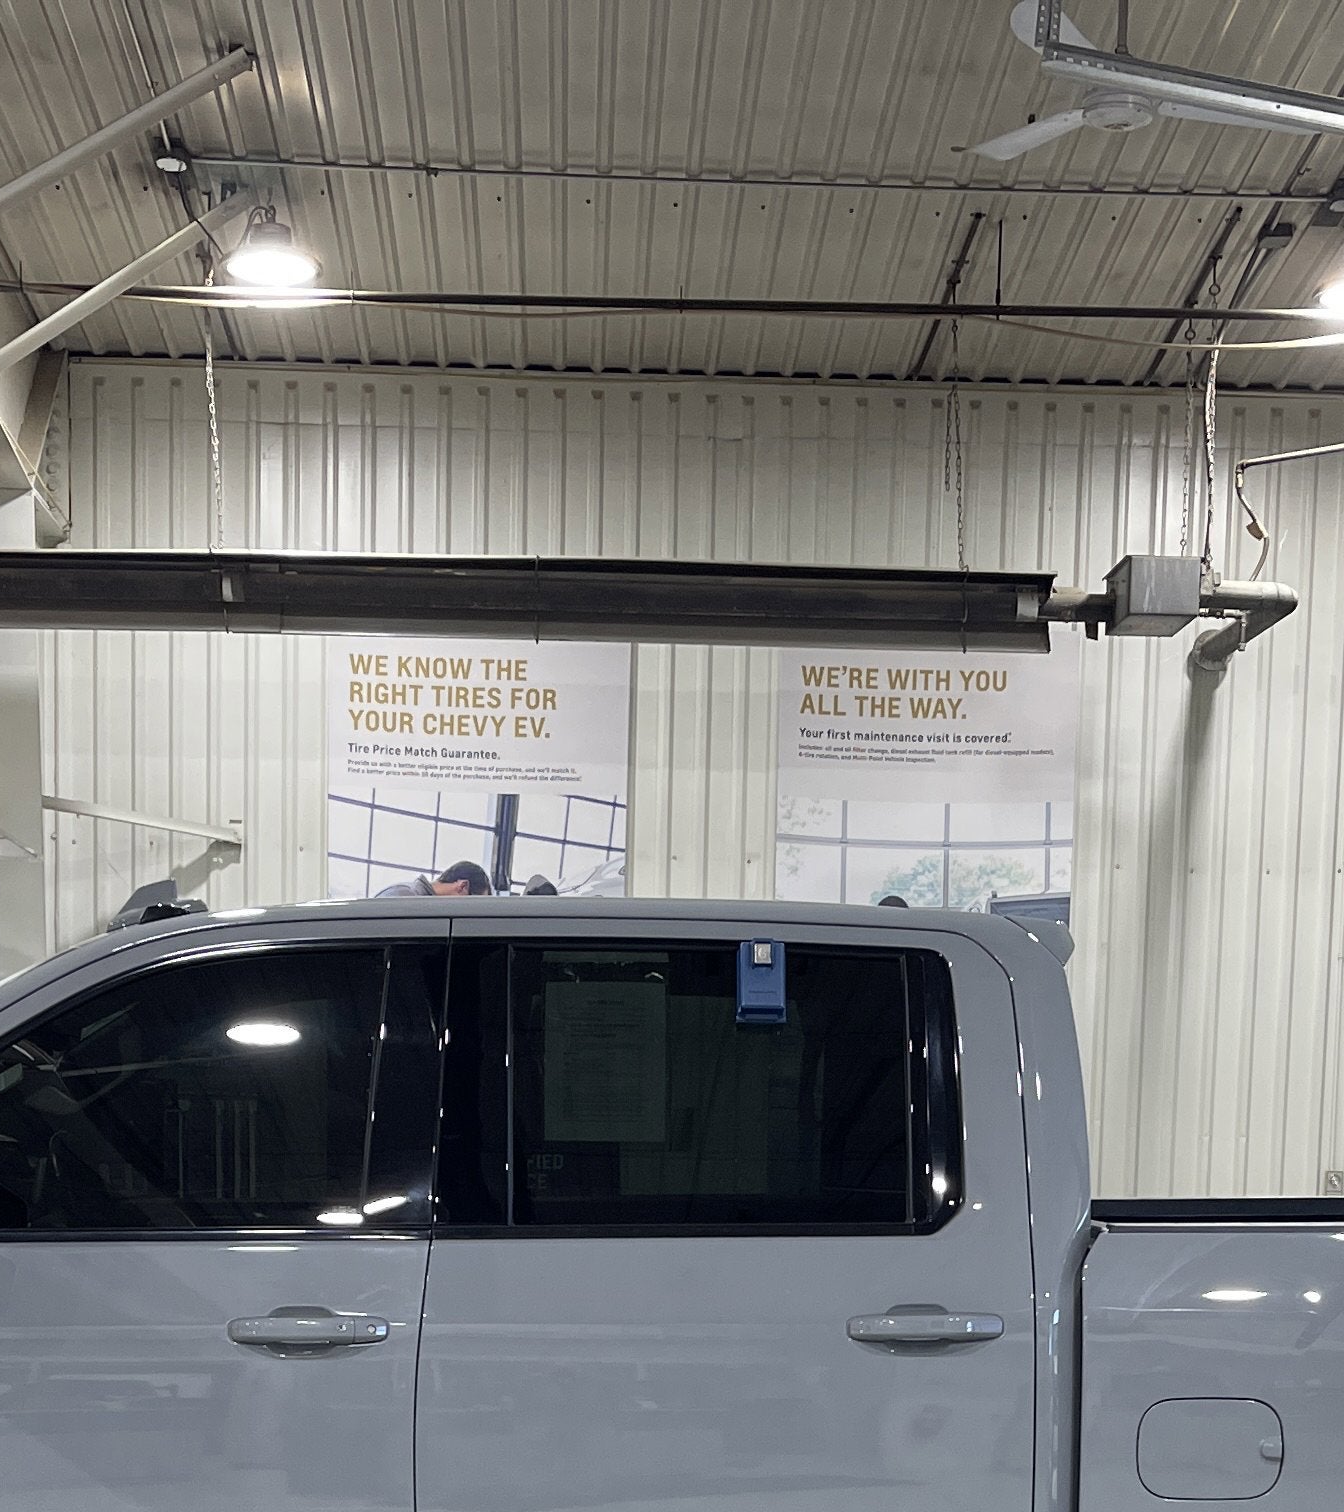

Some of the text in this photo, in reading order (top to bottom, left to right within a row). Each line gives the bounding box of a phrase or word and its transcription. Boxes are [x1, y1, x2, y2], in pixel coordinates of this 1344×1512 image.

[349, 653, 528, 681] WE KNOW THE
[801, 665, 1007, 692] WE'RE WITH YOU
[349, 681, 557, 710] RIGHT TIRES FOR
[800, 693, 967, 719] ALL THE WAY.
[348, 710, 550, 738] YOUR CHEVY EV.
[799, 728, 824, 739] Your
[827, 728, 850, 740] first
[854, 731, 923, 743] maintenance
[927, 732, 950, 743] visit
[953, 733, 961, 743] is
[348, 743, 501, 760] Tire Price Match Guarantee.
